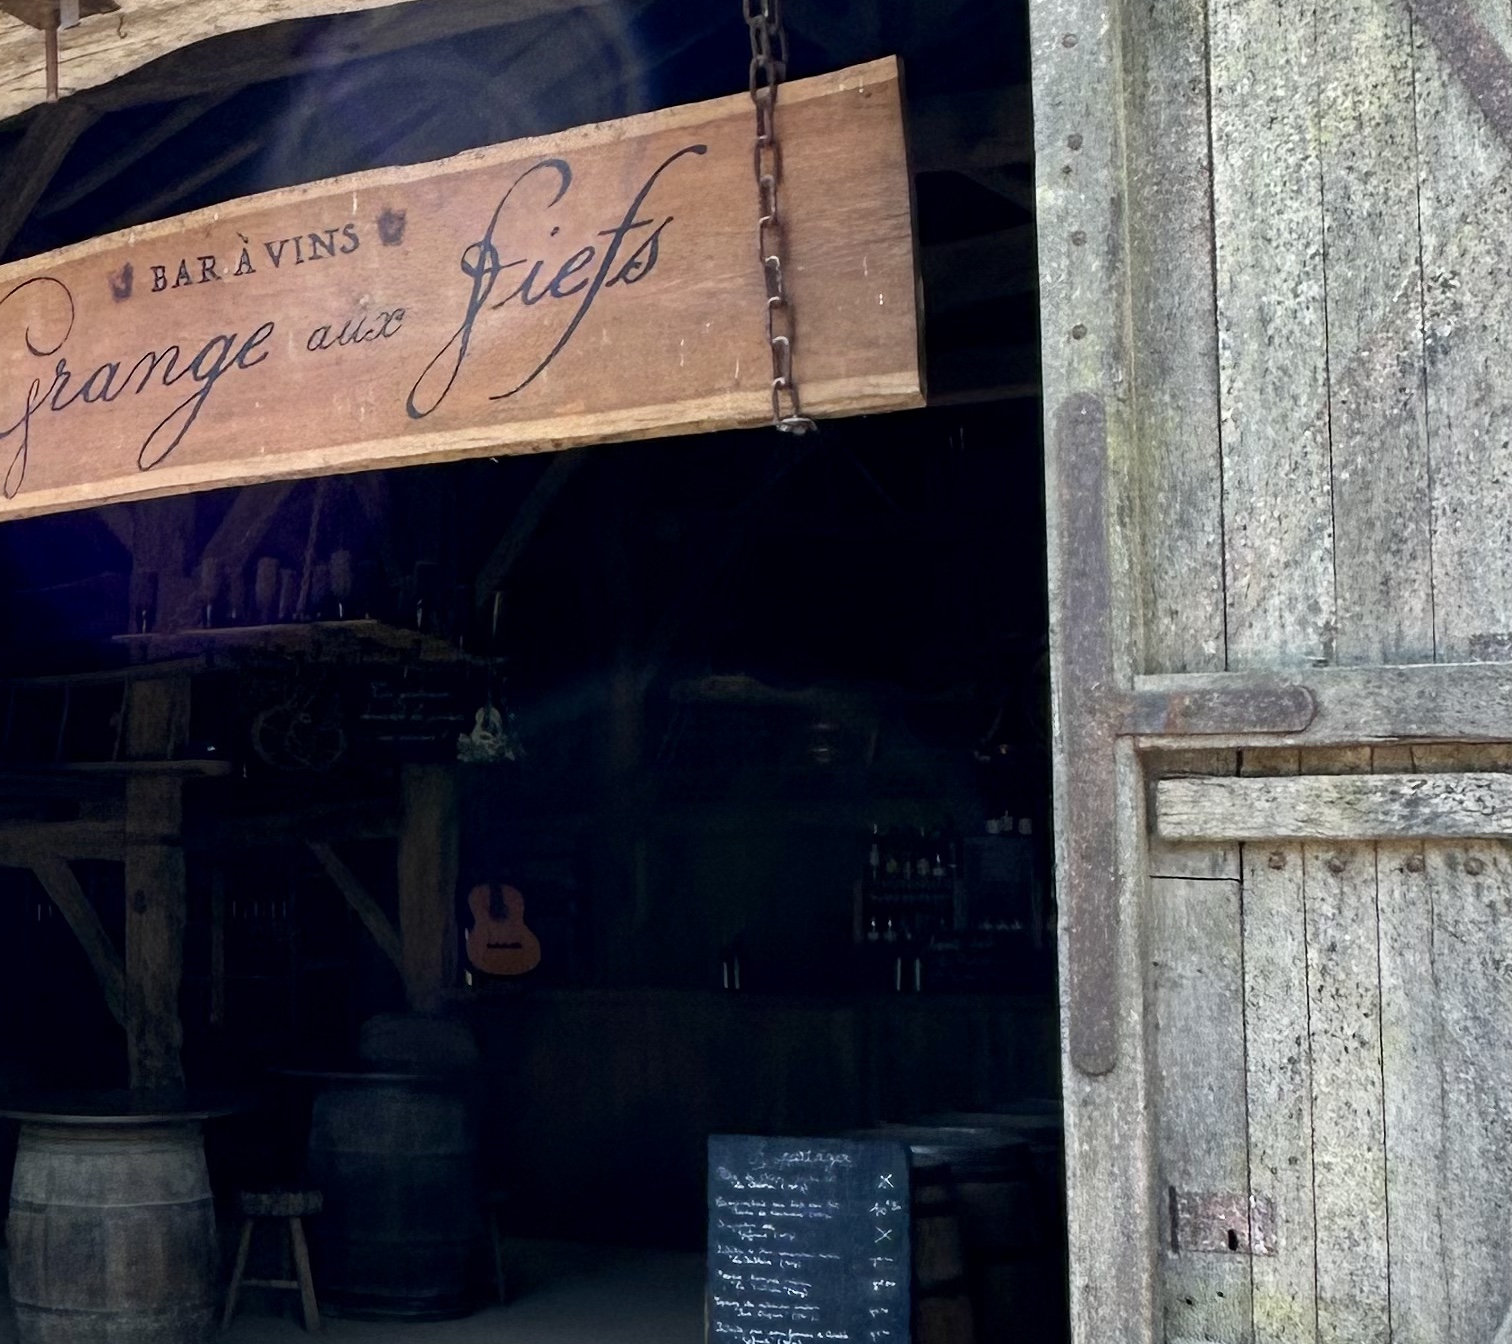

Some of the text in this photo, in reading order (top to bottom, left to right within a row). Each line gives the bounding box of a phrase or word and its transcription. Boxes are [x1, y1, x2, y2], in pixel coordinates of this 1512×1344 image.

[150, 223, 360, 293] BAR À VINS
[305, 305, 406, 353] aux
